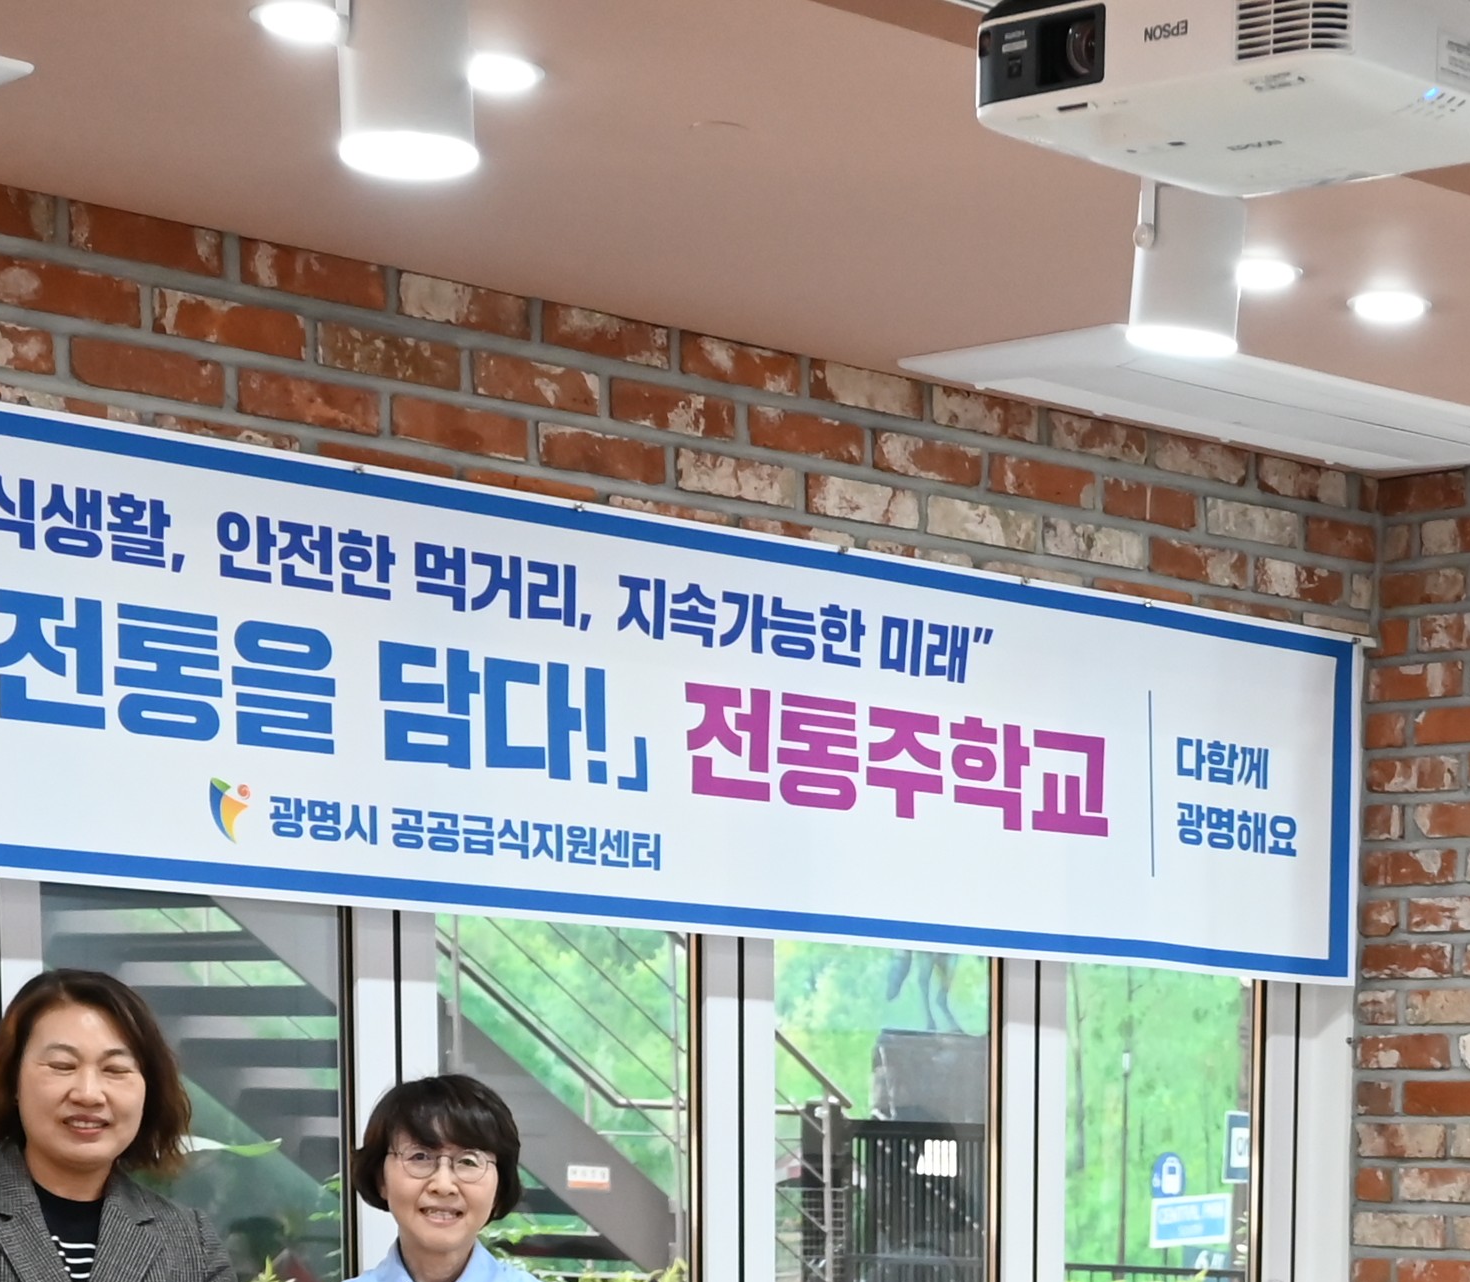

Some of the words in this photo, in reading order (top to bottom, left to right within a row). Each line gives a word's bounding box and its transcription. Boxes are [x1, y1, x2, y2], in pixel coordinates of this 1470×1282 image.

[1143, 19, 1189, 42] EPSON
[215, 511, 397, 602] 안전한
[413, 541, 593, 635] 먹거리,
[616, 574, 867, 669] 지속가능한
[683, 681, 1110, 839] 전통주학교
[1175, 735, 1270, 791] 다함께
[268, 794, 379, 847] 광명시
[390, 809, 662, 872] 공공급식지원센터
[1176, 801, 1298, 859] 광명해요
